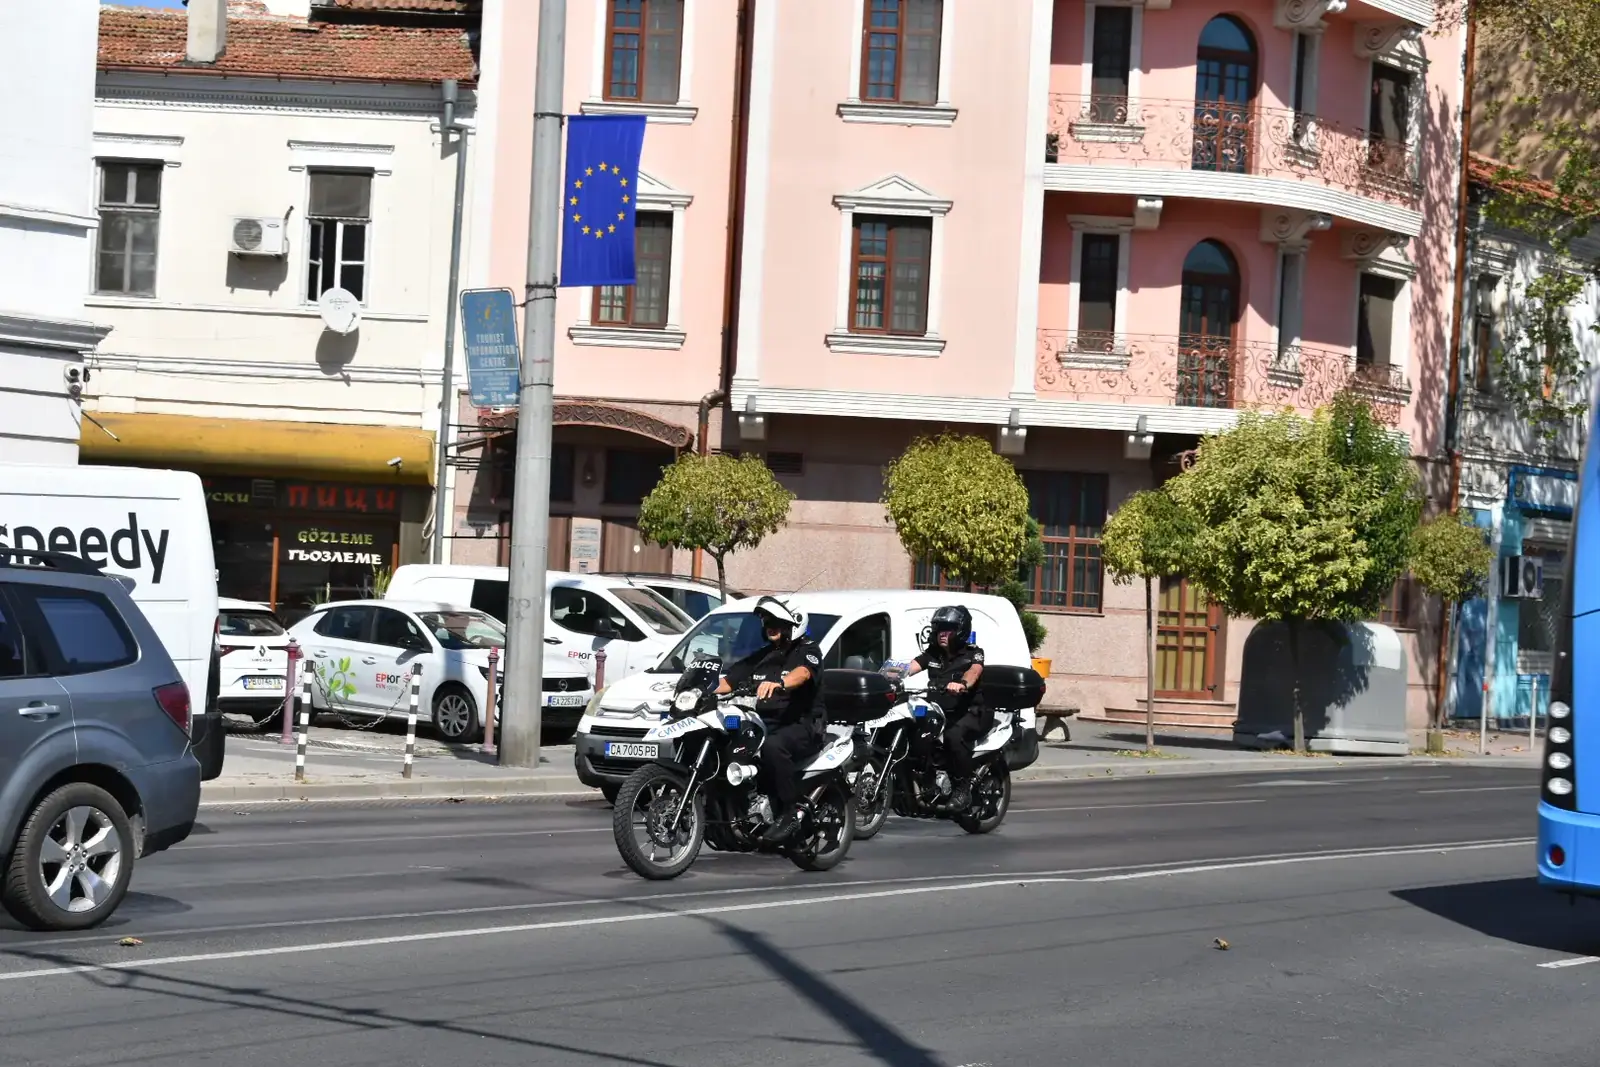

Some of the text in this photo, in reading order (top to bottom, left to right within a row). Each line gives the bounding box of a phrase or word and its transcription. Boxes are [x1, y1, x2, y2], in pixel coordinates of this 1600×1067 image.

[476, 333, 504, 343] TOURIST
[468, 344, 516, 356] INFORMATION
[480, 355, 506, 368] CENTRE
[297, 528, 374, 545] GÖZLEME
[288, 549, 382, 565] ГЬОЗЛЕМЕ
[657, 717, 696, 738] СИГМА
[622, 745, 644, 756] 7005
